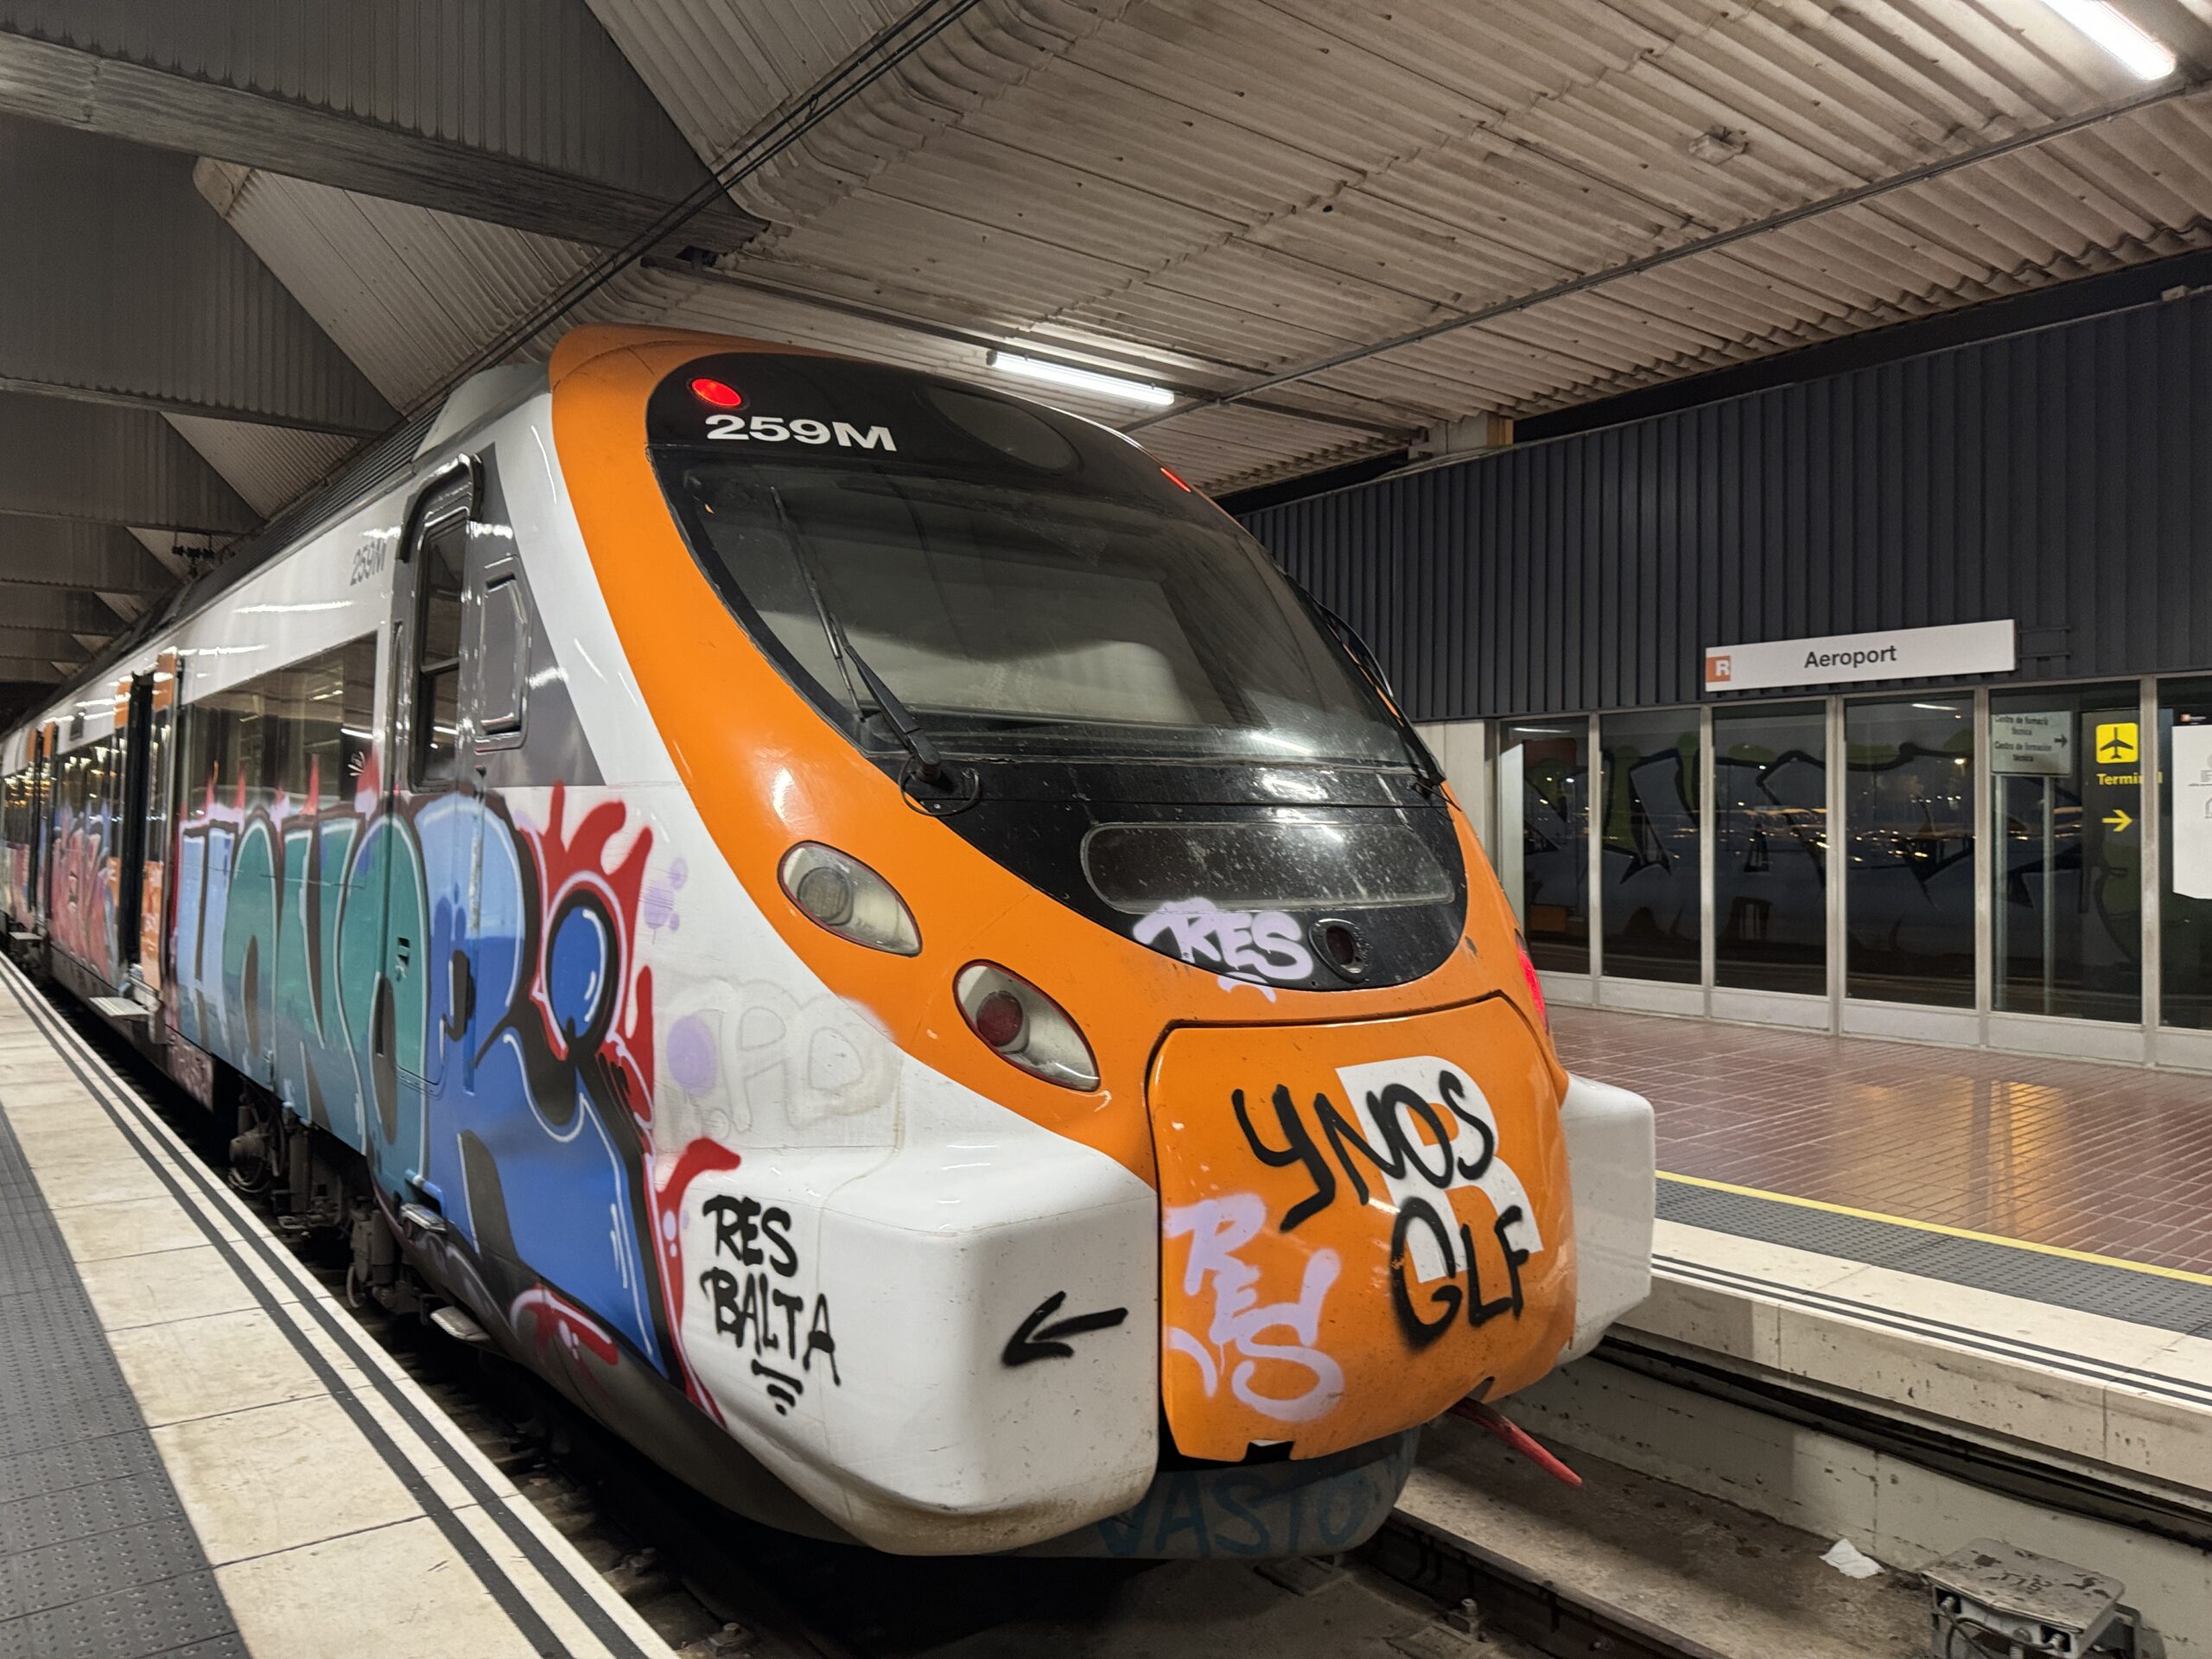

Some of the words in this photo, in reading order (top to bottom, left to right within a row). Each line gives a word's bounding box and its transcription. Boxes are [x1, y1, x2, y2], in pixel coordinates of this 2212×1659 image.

[705, 414, 898, 452] 259M
[1804, 645, 1897, 669] Aeroport
[1133, 896, 1313, 980] RES
[702, 1194, 798, 1277] RES
[700, 1267, 842, 1388] BALTA
